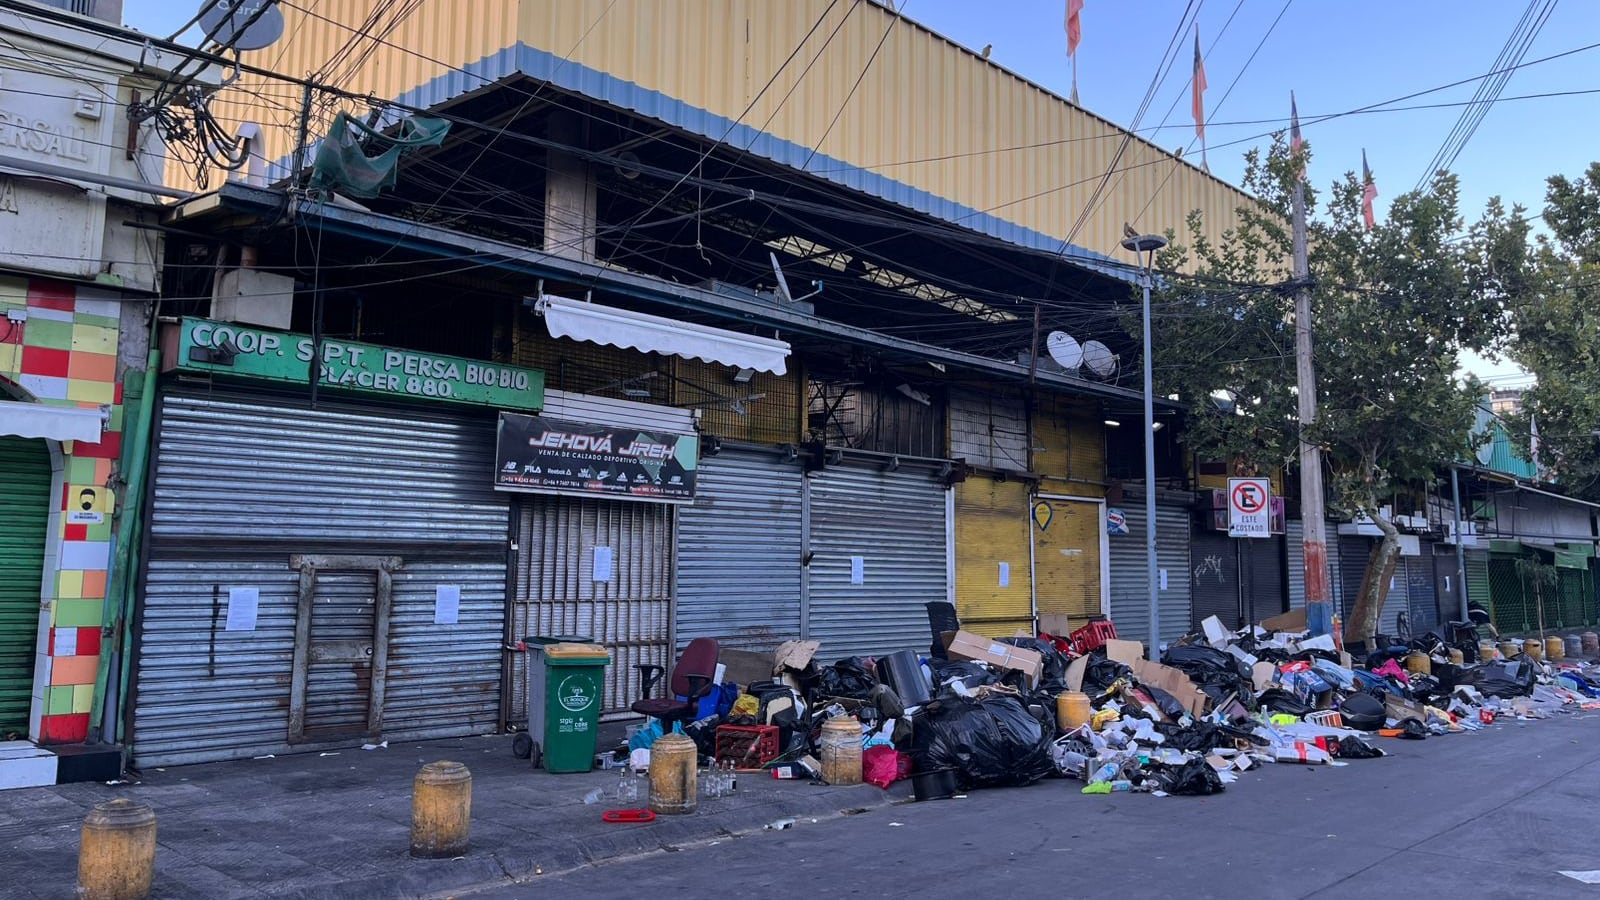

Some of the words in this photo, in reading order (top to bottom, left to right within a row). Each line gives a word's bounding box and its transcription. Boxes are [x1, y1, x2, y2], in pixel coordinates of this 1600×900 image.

[191, 324, 284, 356] COOP.
[384, 351, 460, 382] PERSA
[529, 431, 612, 453] JEHOVÁ
[538, 449, 560, 458] VENTA
[572, 452, 602, 461] CALZADO
[604, 455, 637, 465] DEPORTIVO
[639, 458, 667, 467] ORIGINAL
[524, 465, 541, 474] FILA
[1241, 515, 1257, 523] ESTE
